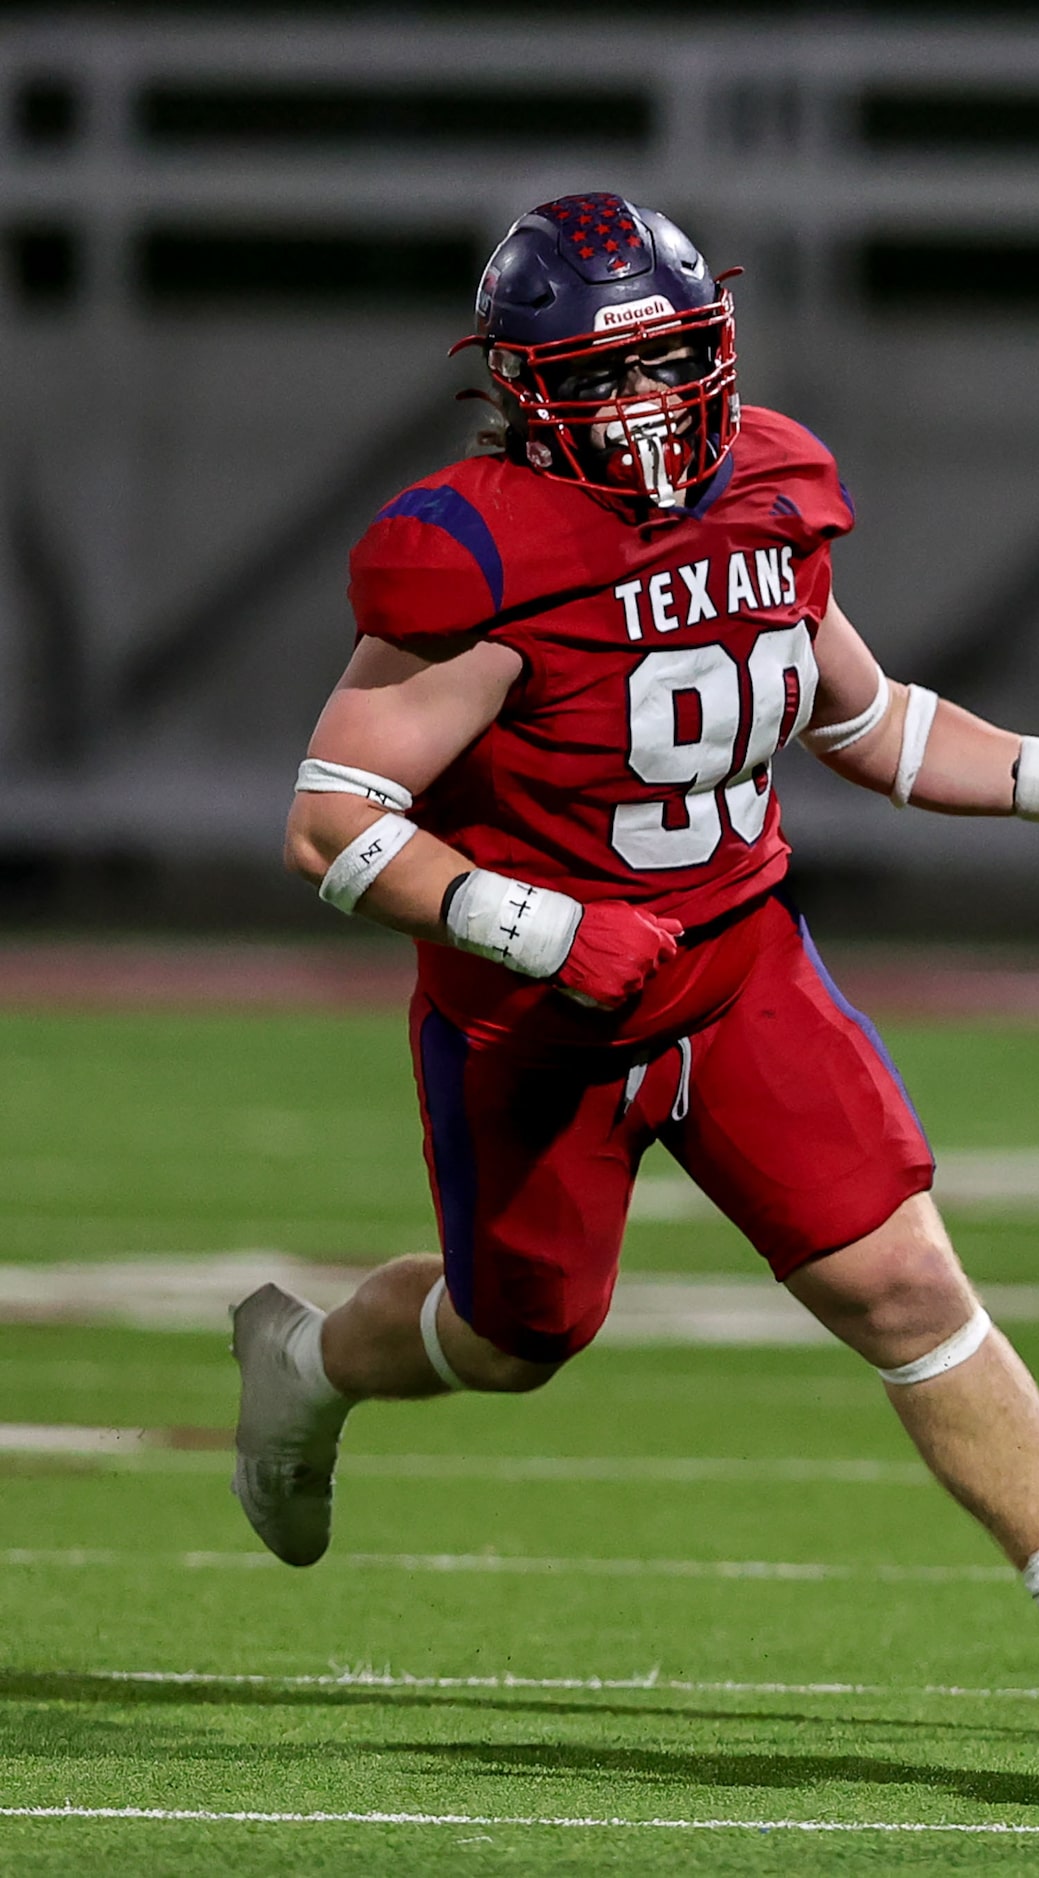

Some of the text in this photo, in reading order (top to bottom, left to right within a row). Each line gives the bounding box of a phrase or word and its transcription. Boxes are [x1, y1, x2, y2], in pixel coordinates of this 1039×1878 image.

[604, 301, 664, 325] Riddell
[615, 546, 796, 641] TEXANS
[611, 619, 819, 869] 90
